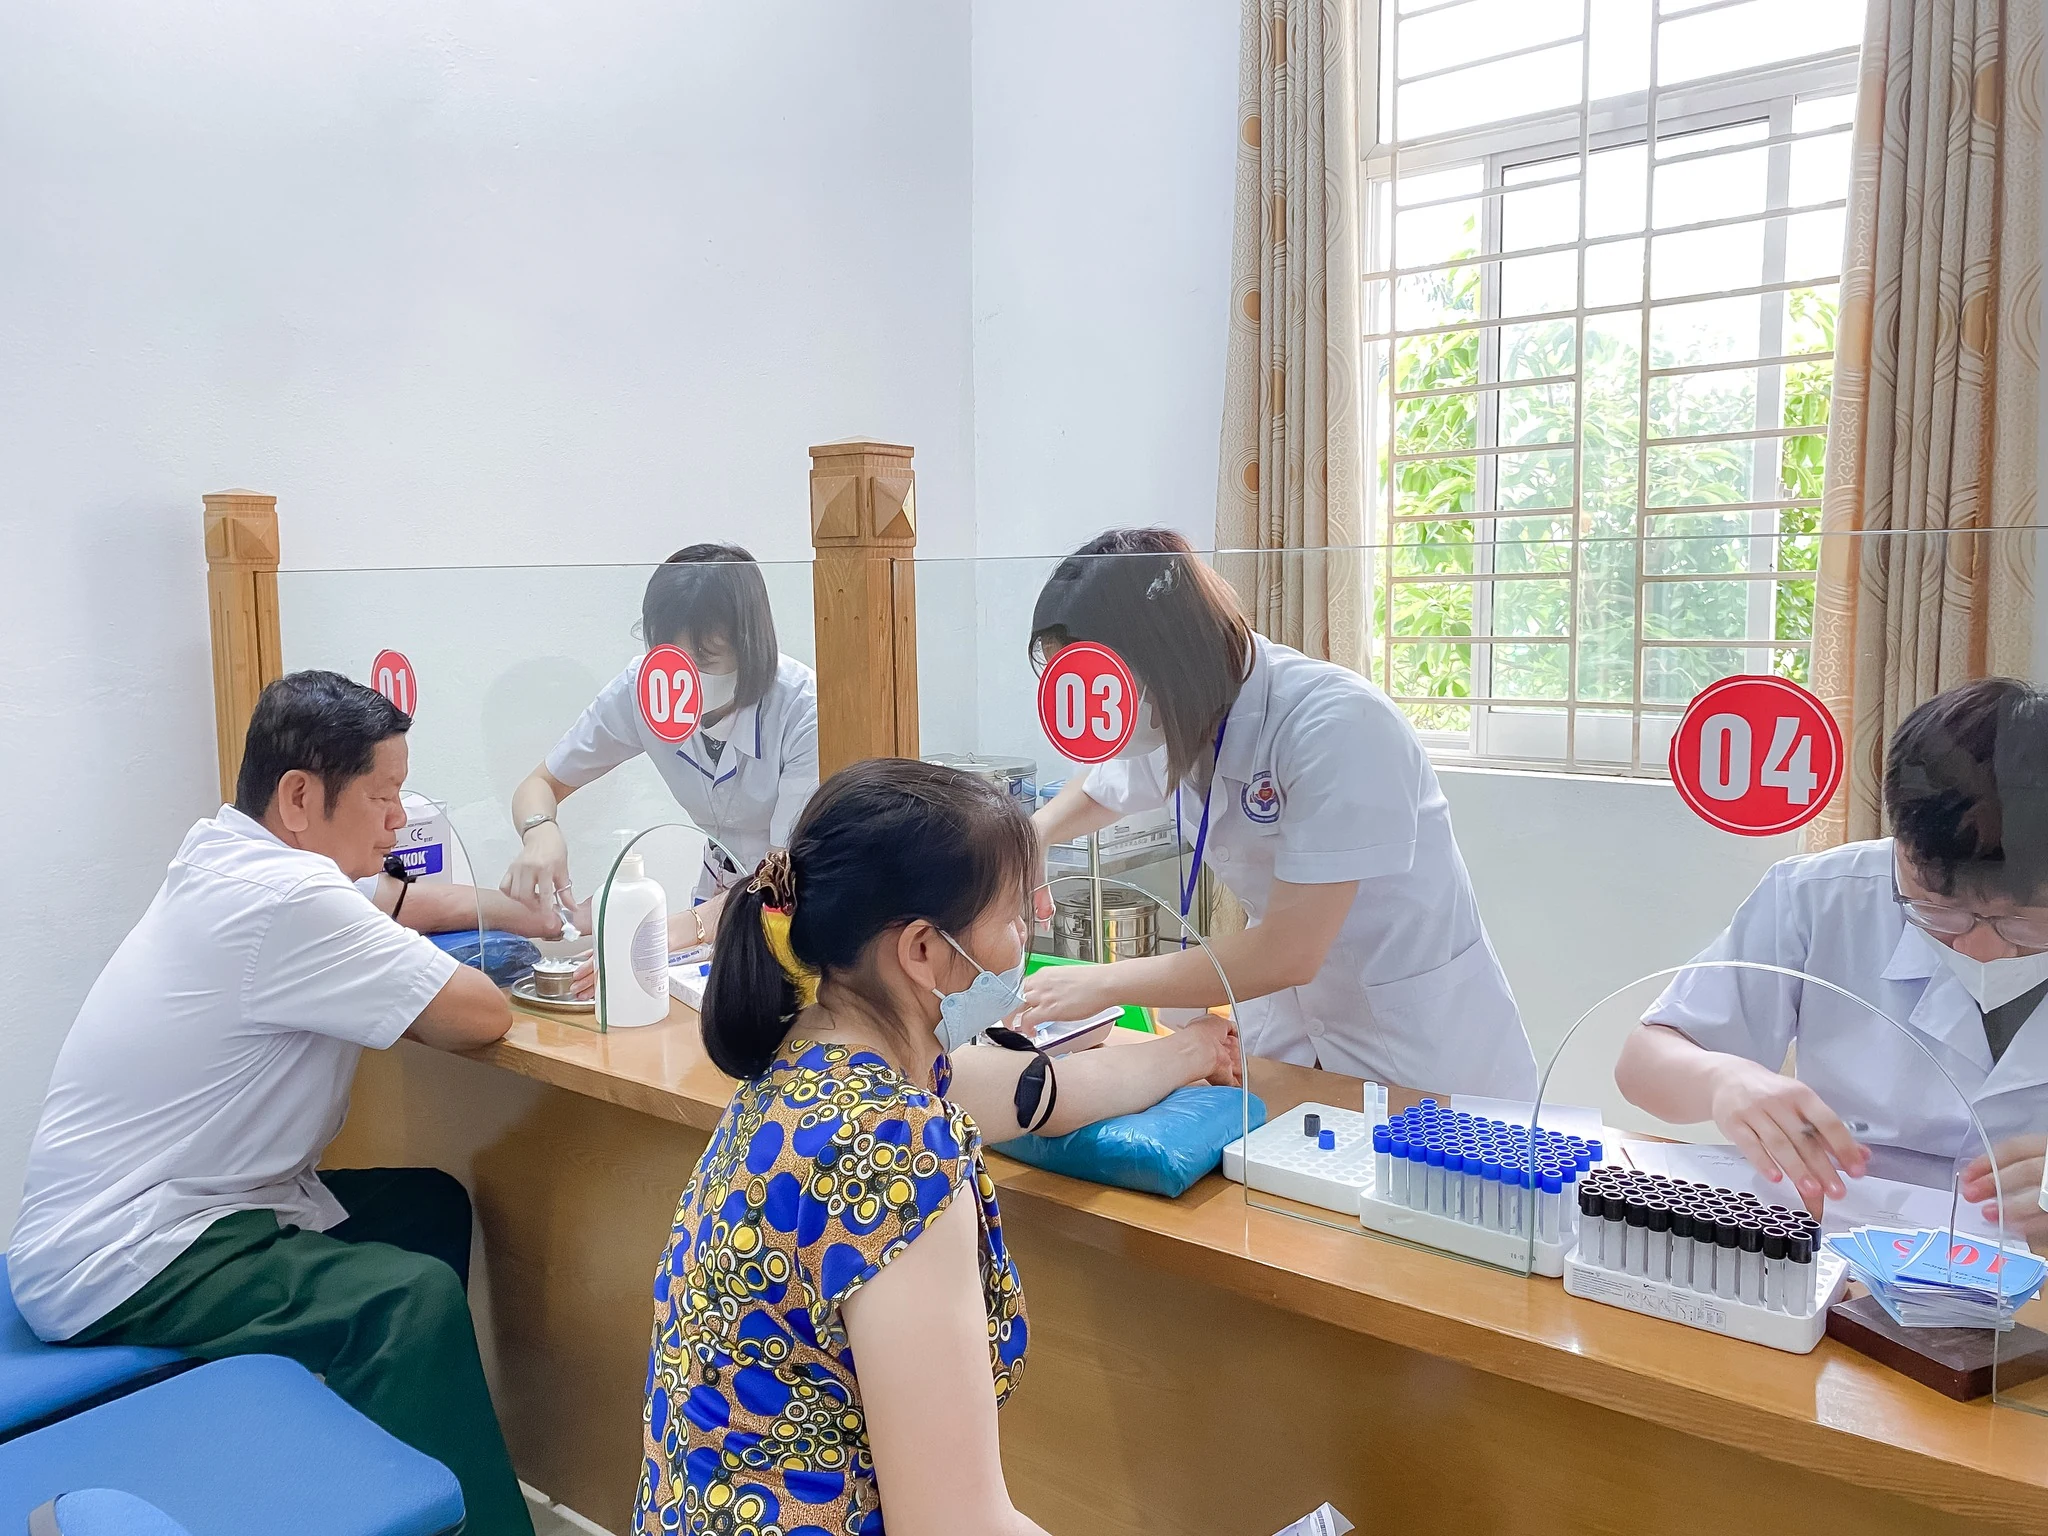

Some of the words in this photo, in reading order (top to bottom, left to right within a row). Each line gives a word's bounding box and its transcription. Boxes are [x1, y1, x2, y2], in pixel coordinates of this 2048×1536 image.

[378, 667, 408, 716] 01
[648, 668, 695, 724] 02
[1055, 672, 1123, 742] 03
[1700, 712, 1818, 806] 04
